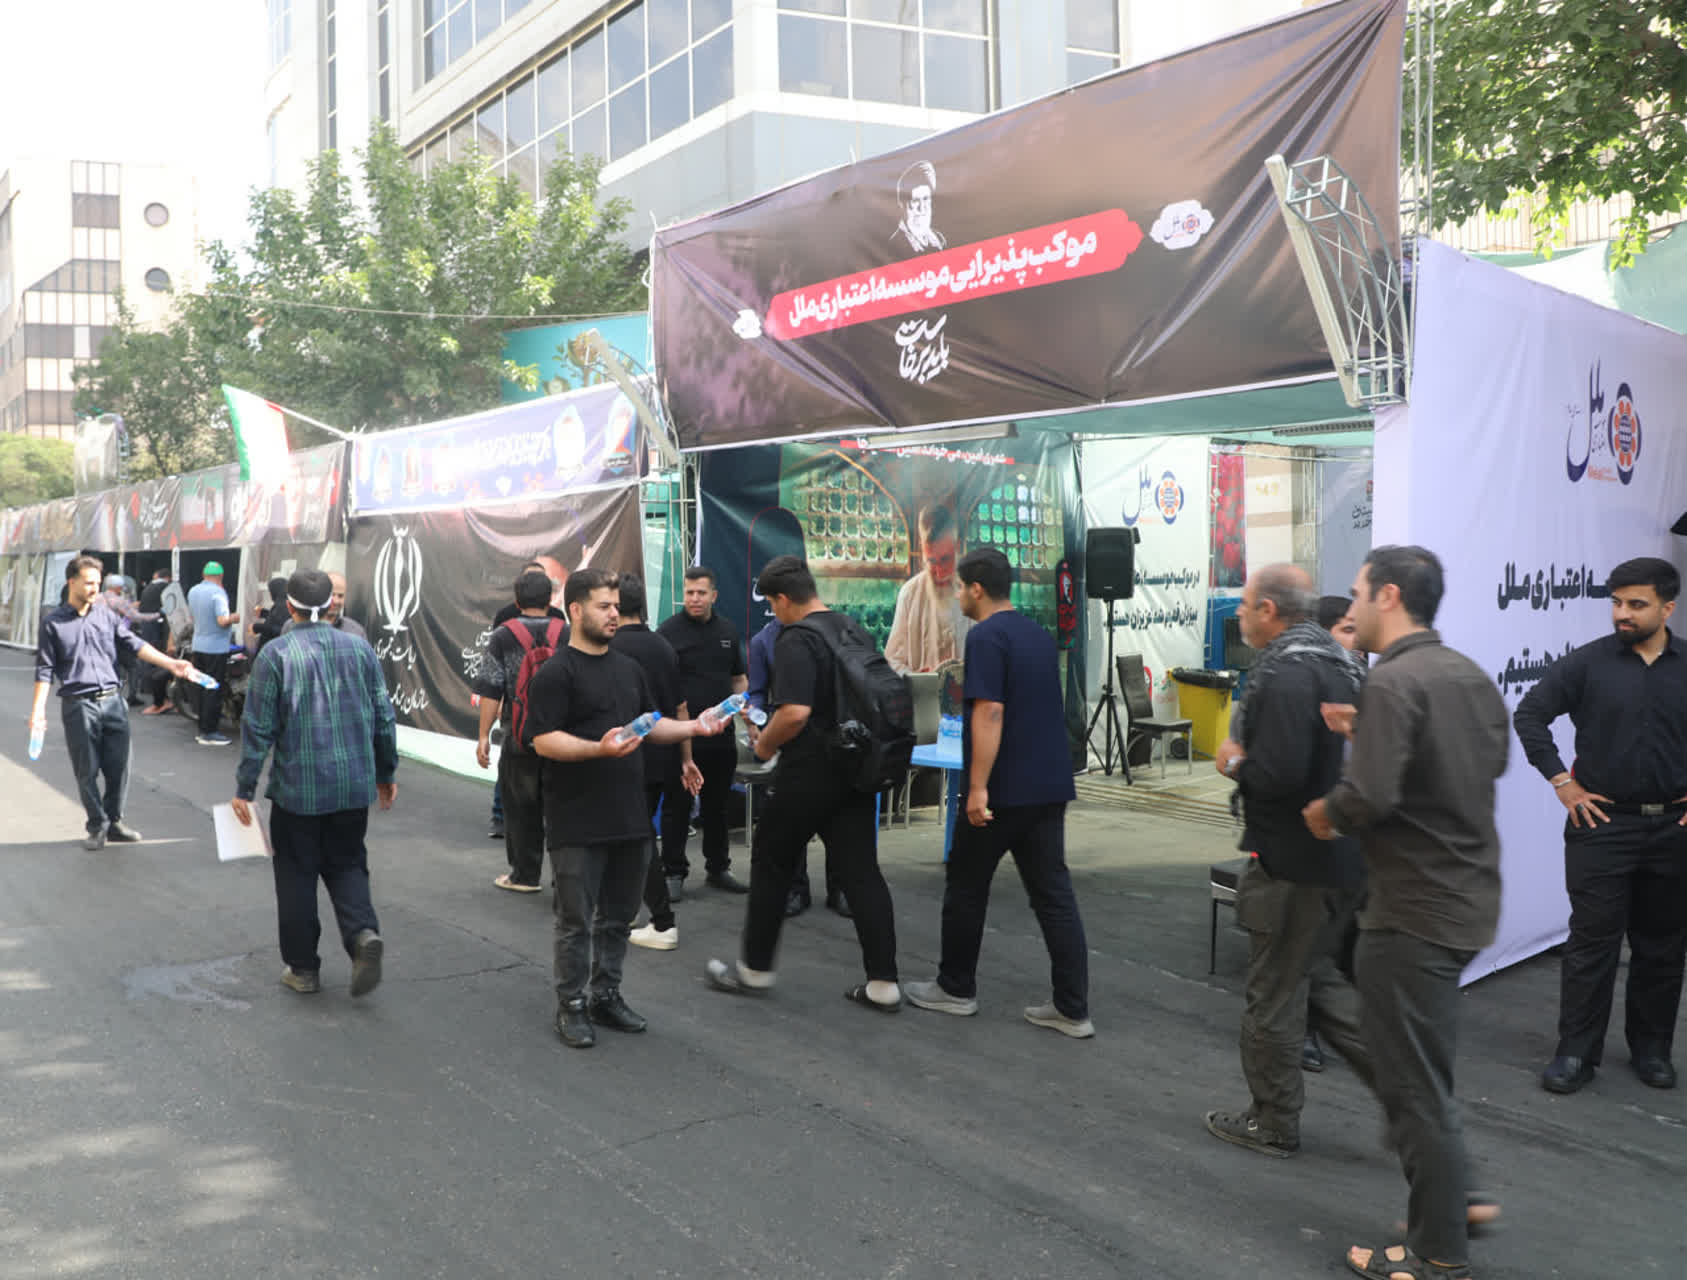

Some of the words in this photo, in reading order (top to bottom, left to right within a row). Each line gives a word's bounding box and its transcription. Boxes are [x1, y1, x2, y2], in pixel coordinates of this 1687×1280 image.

[951, 238, 1028, 293] پذیرایی
[1029, 229, 1097, 275] موکب
[816, 275, 877, 322] اعتباری
[877, 265, 950, 298] موسسه
[789, 293, 816, 328] ملل
[1497, 561, 1531, 611] ملل
[1531, 562, 1586, 612] اعتباری
